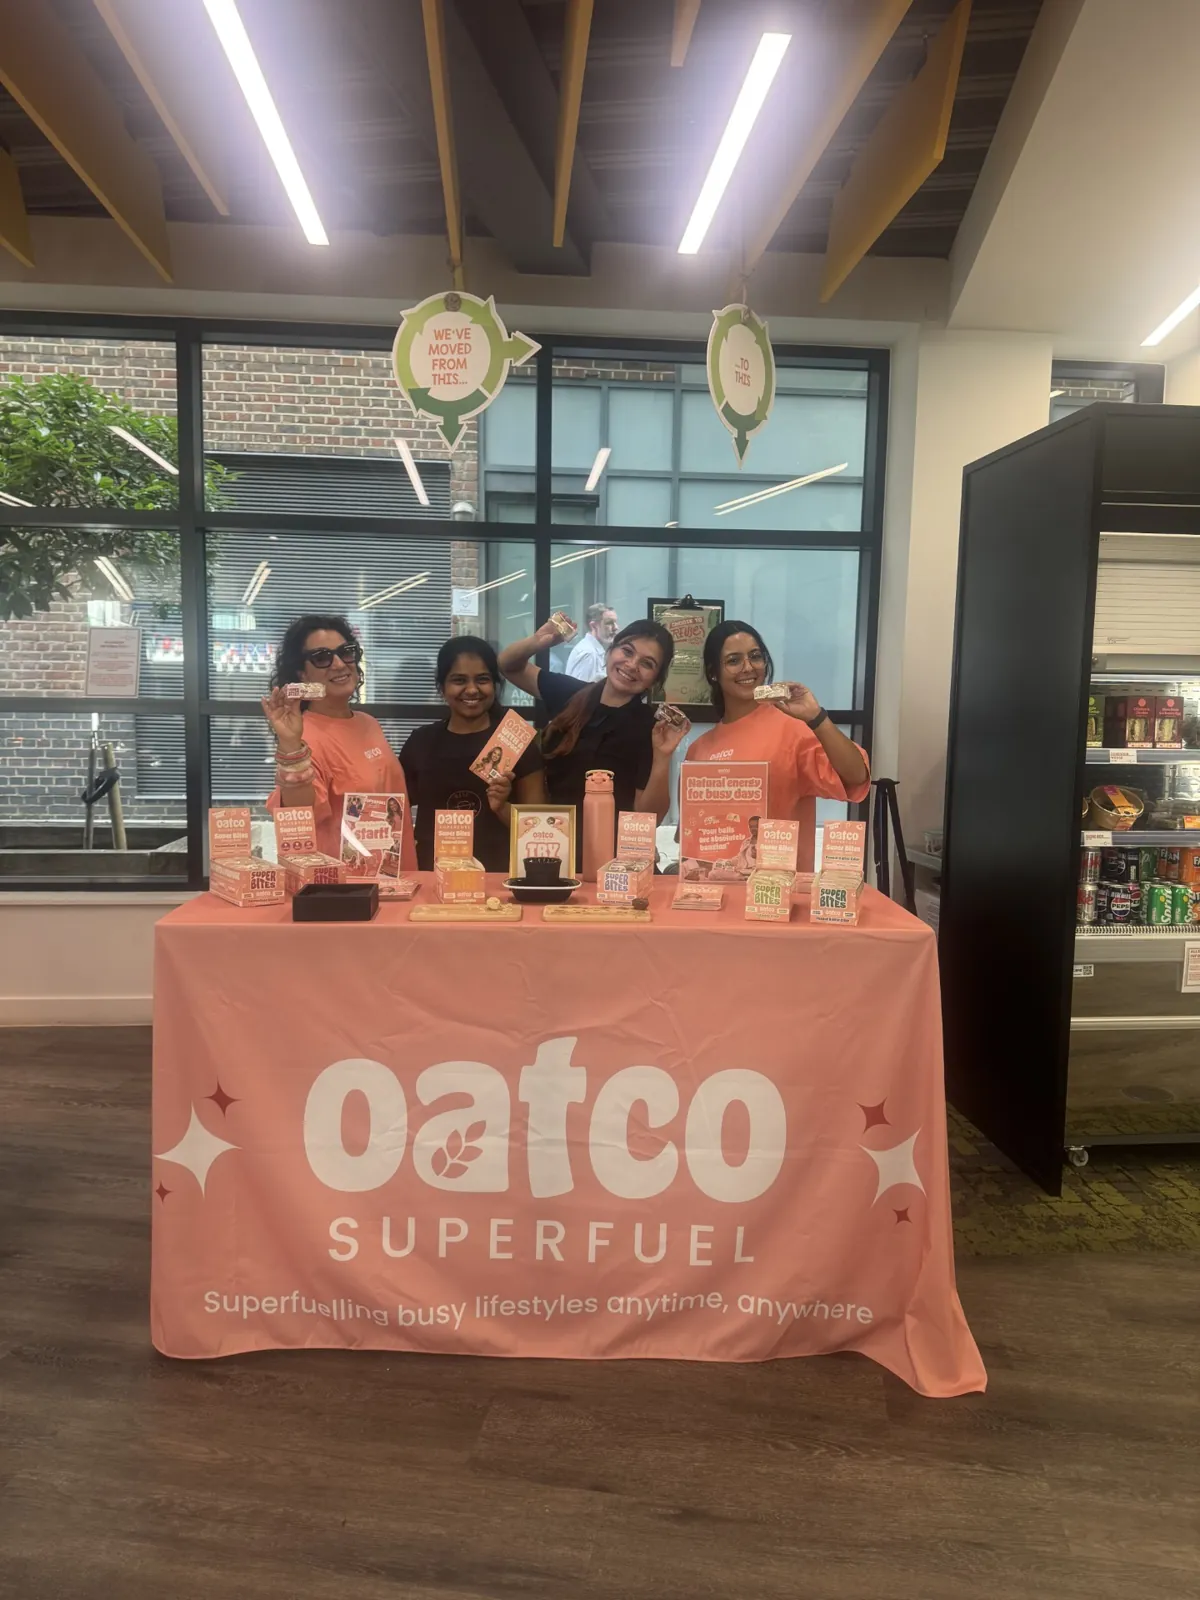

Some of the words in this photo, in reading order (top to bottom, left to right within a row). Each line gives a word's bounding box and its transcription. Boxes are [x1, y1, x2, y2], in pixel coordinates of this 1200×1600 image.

[434, 328, 471, 340] WE'VE
[428, 343, 472, 356] MOVED
[432, 358, 467, 370] FROM
[432, 373, 468, 385] THIS...
[735, 370, 751, 387] THIS
[505, 718, 531, 743] OATS
[687, 776, 726, 788] Natural
[727, 777, 762, 789] energy
[687, 787, 705, 800] for
[705, 787, 732, 801] busy
[733, 787, 762, 801] days
[276, 809, 312, 821] oatco
[437, 812, 472, 825] oatco
[216, 818, 245, 829] oatco
[623, 822, 650, 832] oatco
[355, 827, 389, 840] start!
[533, 831, 554, 839] oatco
[764, 830, 792, 841] oatco
[829, 830, 859, 841] oatco
[526, 842, 561, 858] TRY
[251, 871, 276, 882] SUPER
[314, 867, 339, 879] SUPER
[605, 872, 629, 885] SUPER
[250, 878, 276, 890] BITES
[604, 881, 629, 892] BITES
[755, 885, 781, 898] SUPER
[820, 888, 847, 902] SUPER
[754, 892, 781, 905] BITES
[819, 895, 847, 909] BITES
[303, 1036, 787, 1204] oatco
[328, 1216, 754, 1266] SUPERFUEL
[204, 1290, 389, 1326] Superfuelling
[398, 1302, 466, 1330] busy
[475, 1295, 598, 1322] lifestyles
[607, 1291, 729, 1322] anytime,
[737, 1293, 874, 1325] anywhere
